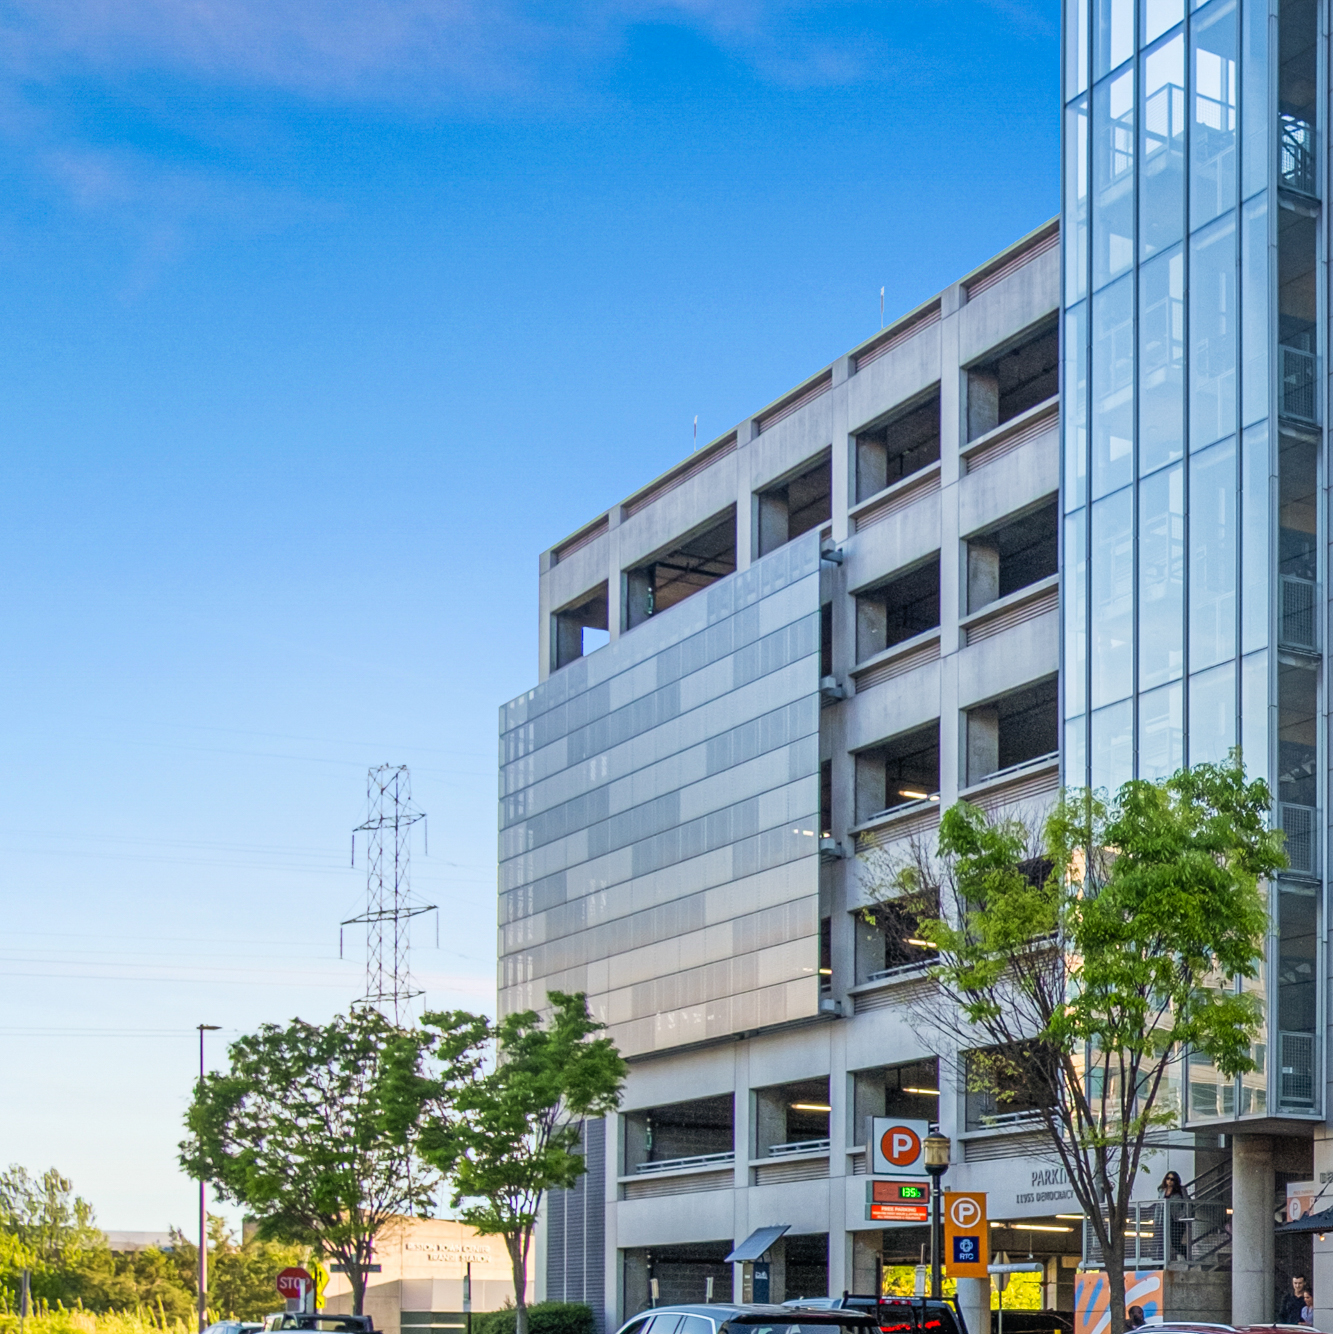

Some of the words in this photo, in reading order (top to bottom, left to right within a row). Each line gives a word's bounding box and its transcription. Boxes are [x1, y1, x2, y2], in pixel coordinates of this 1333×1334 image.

[892, 1133, 913, 1159] P
[1036, 1189, 1075, 1202] DEMOCRACY
[958, 1203, 975, 1222] P
